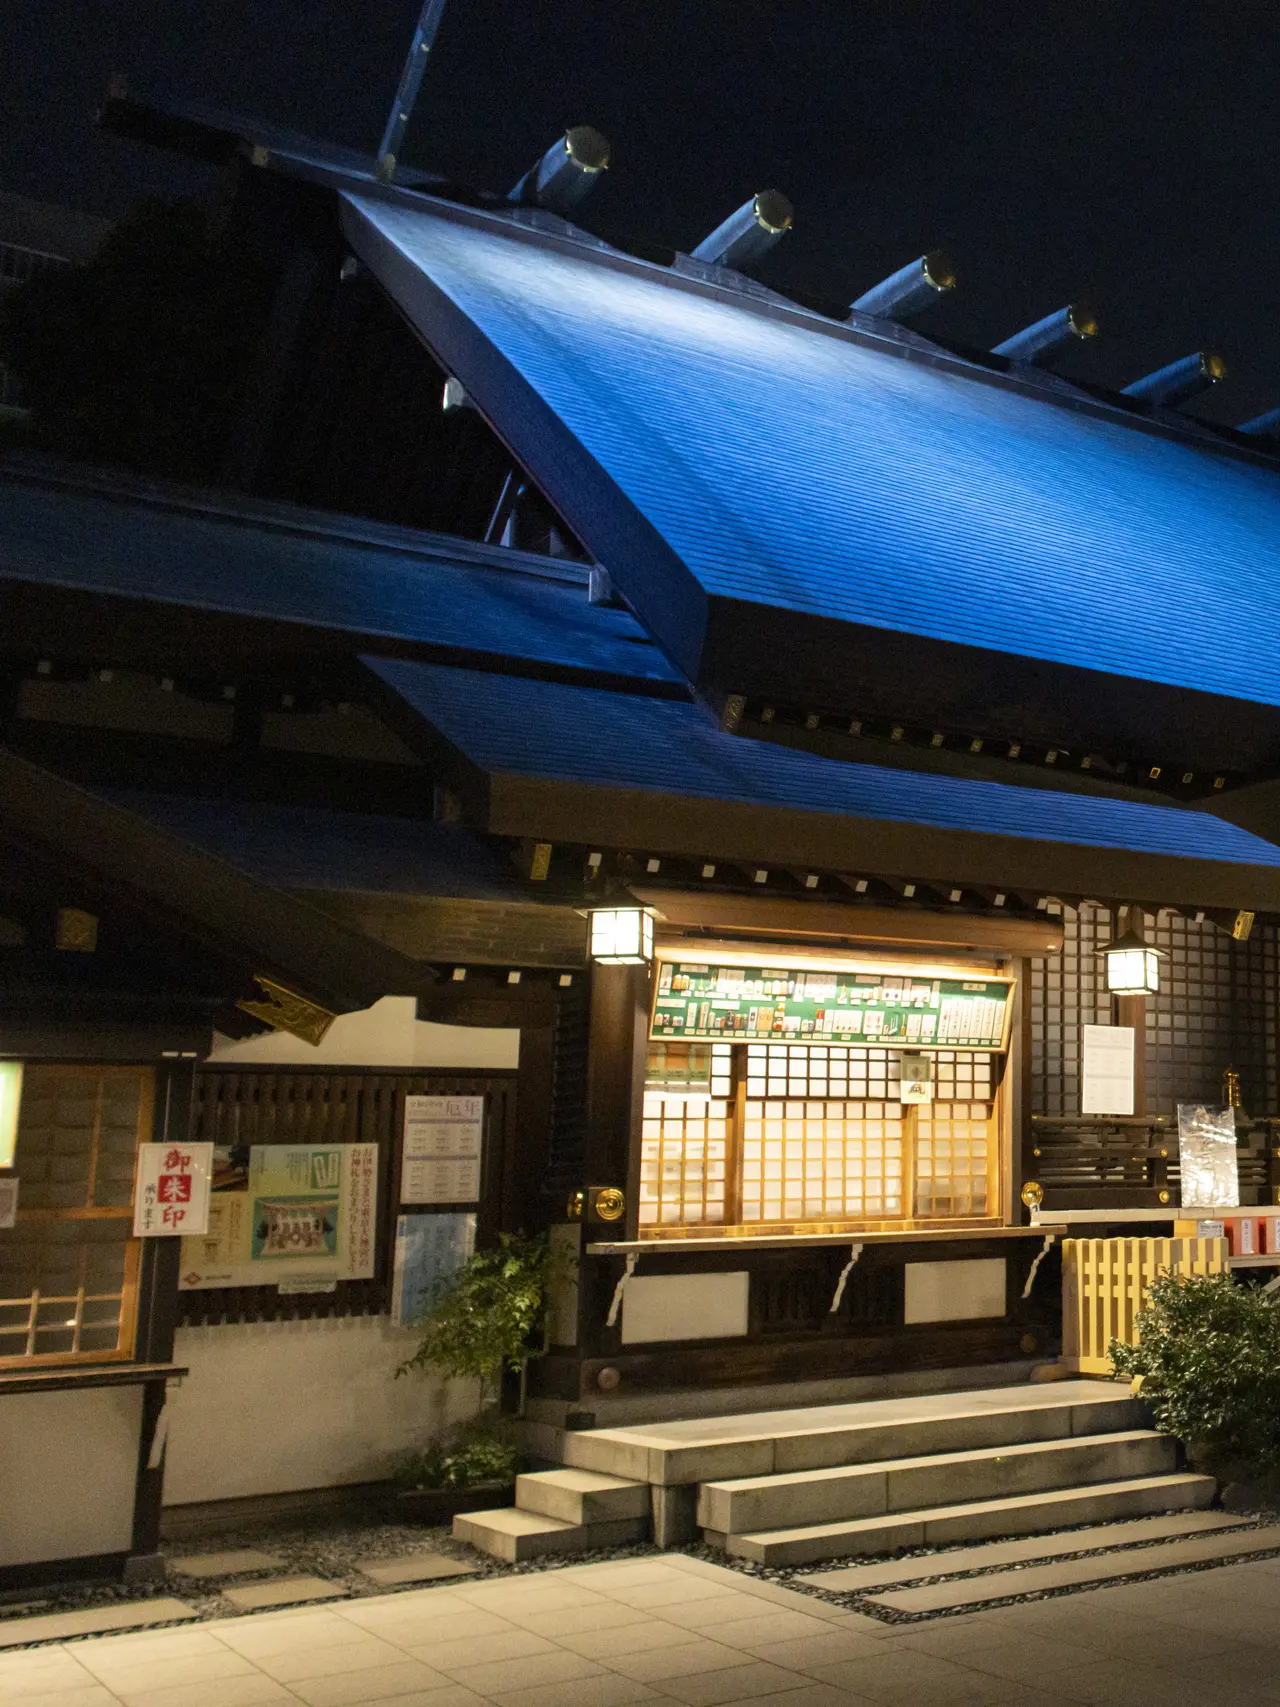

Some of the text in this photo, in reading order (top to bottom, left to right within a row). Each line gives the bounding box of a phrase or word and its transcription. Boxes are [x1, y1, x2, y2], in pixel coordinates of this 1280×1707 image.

[143, 1184, 156, 1230] 承ります
[161, 1149, 191, 1229] 御朱印
